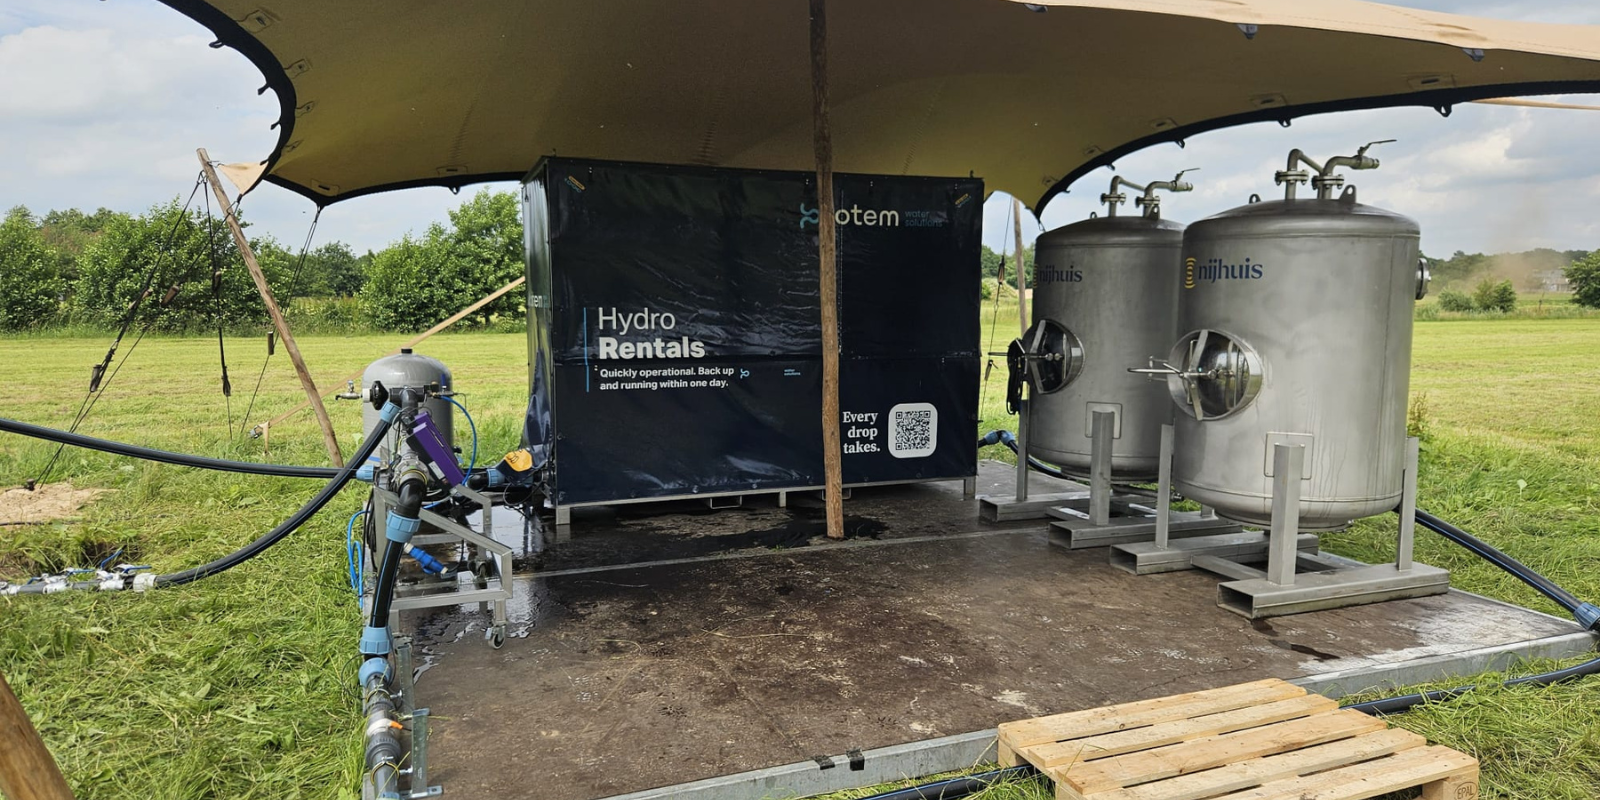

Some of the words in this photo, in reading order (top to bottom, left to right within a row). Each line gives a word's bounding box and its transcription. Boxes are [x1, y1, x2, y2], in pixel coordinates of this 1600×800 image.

[835, 204, 899, 227] otem
[904, 209, 930, 218] water
[904, 218, 943, 228] solutions
[1039, 264, 1083, 285] nijhuis
[1198, 257, 1263, 283] nijhuis
[598, 307, 676, 335] Hydro
[599, 336, 705, 360] Rentals
[599, 368, 637, 379] Quickly
[639, 367, 696, 379] operational.
[698, 367, 720, 376] Back
[722, 367, 735, 379] up
[599, 381, 618, 391] and
[620, 380, 658, 392] running
[659, 379, 688, 390] within
[690, 380, 708, 390] one
[710, 379, 729, 391] day.
[842, 411, 878, 425] Every
[848, 425, 878, 440] drop
[843, 441, 880, 454] takes.
[1457, 785, 1474, 799] EPAL
